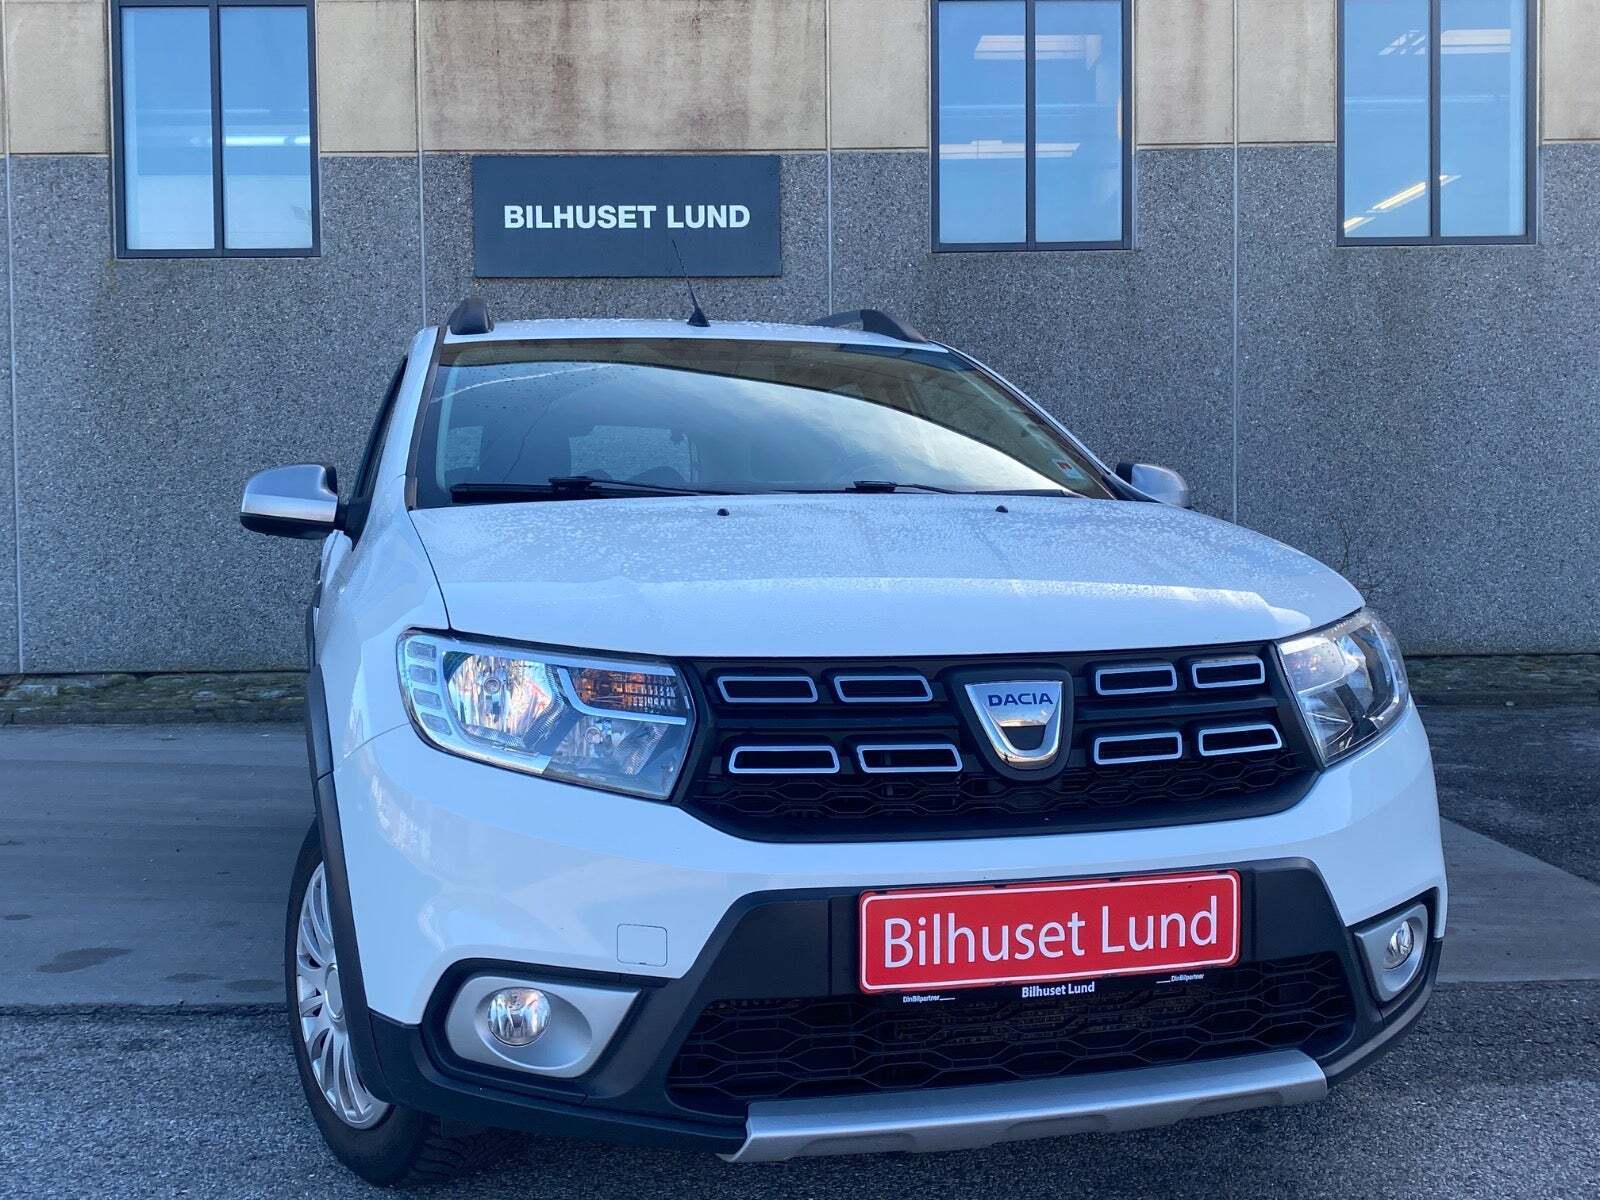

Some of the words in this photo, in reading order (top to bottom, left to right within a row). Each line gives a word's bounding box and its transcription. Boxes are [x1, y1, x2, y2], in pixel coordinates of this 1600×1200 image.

[504, 205, 656, 229] BILHUSET
[667, 205, 751, 229] LUND
[987, 693, 1053, 706] DACIA
[884, 911, 1086, 968] Bilhuset
[1101, 895, 1217, 953] Lund
[1022, 985, 1066, 998] Bilhuset
[1068, 981, 1095, 995] Lund
